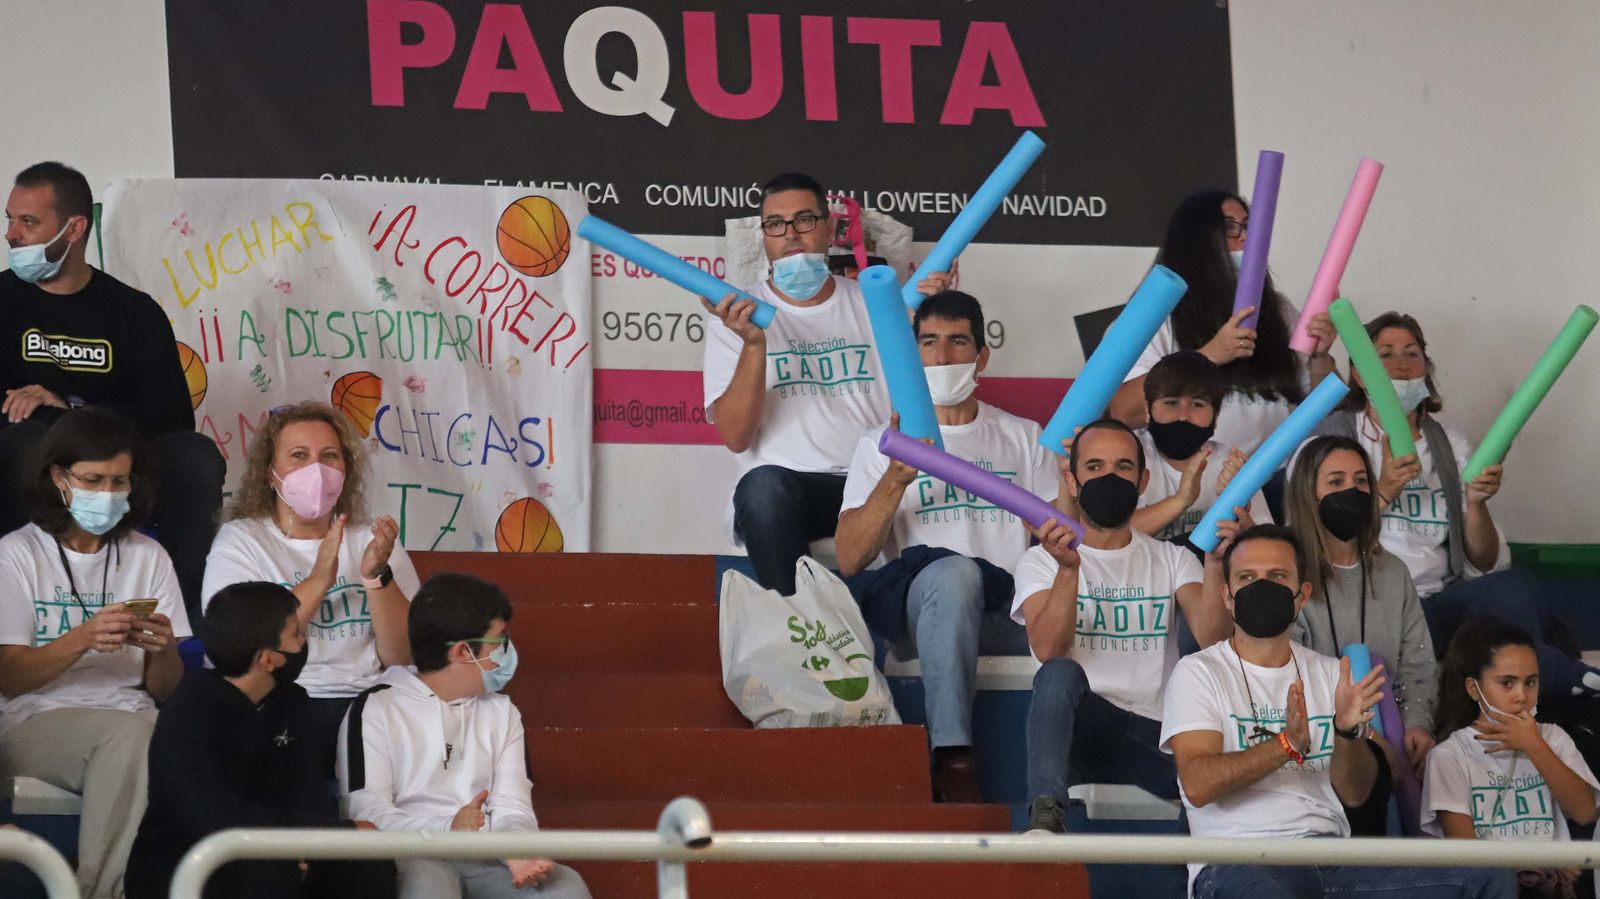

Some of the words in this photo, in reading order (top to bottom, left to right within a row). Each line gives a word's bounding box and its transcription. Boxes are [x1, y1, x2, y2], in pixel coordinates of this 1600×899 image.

[367, 0, 1047, 127] PAQUITA
[645, 182, 762, 208] COMUNIÓ
[1003, 195, 1107, 217] NAVIDAD
[602, 311, 704, 343] 95676
[374, 404, 555, 470] CHICAS!
[1086, 581, 1145, 600] Selección
[1073, 636, 1169, 652] ALONCESTO
[1472, 786, 1547, 822] CÁDI
